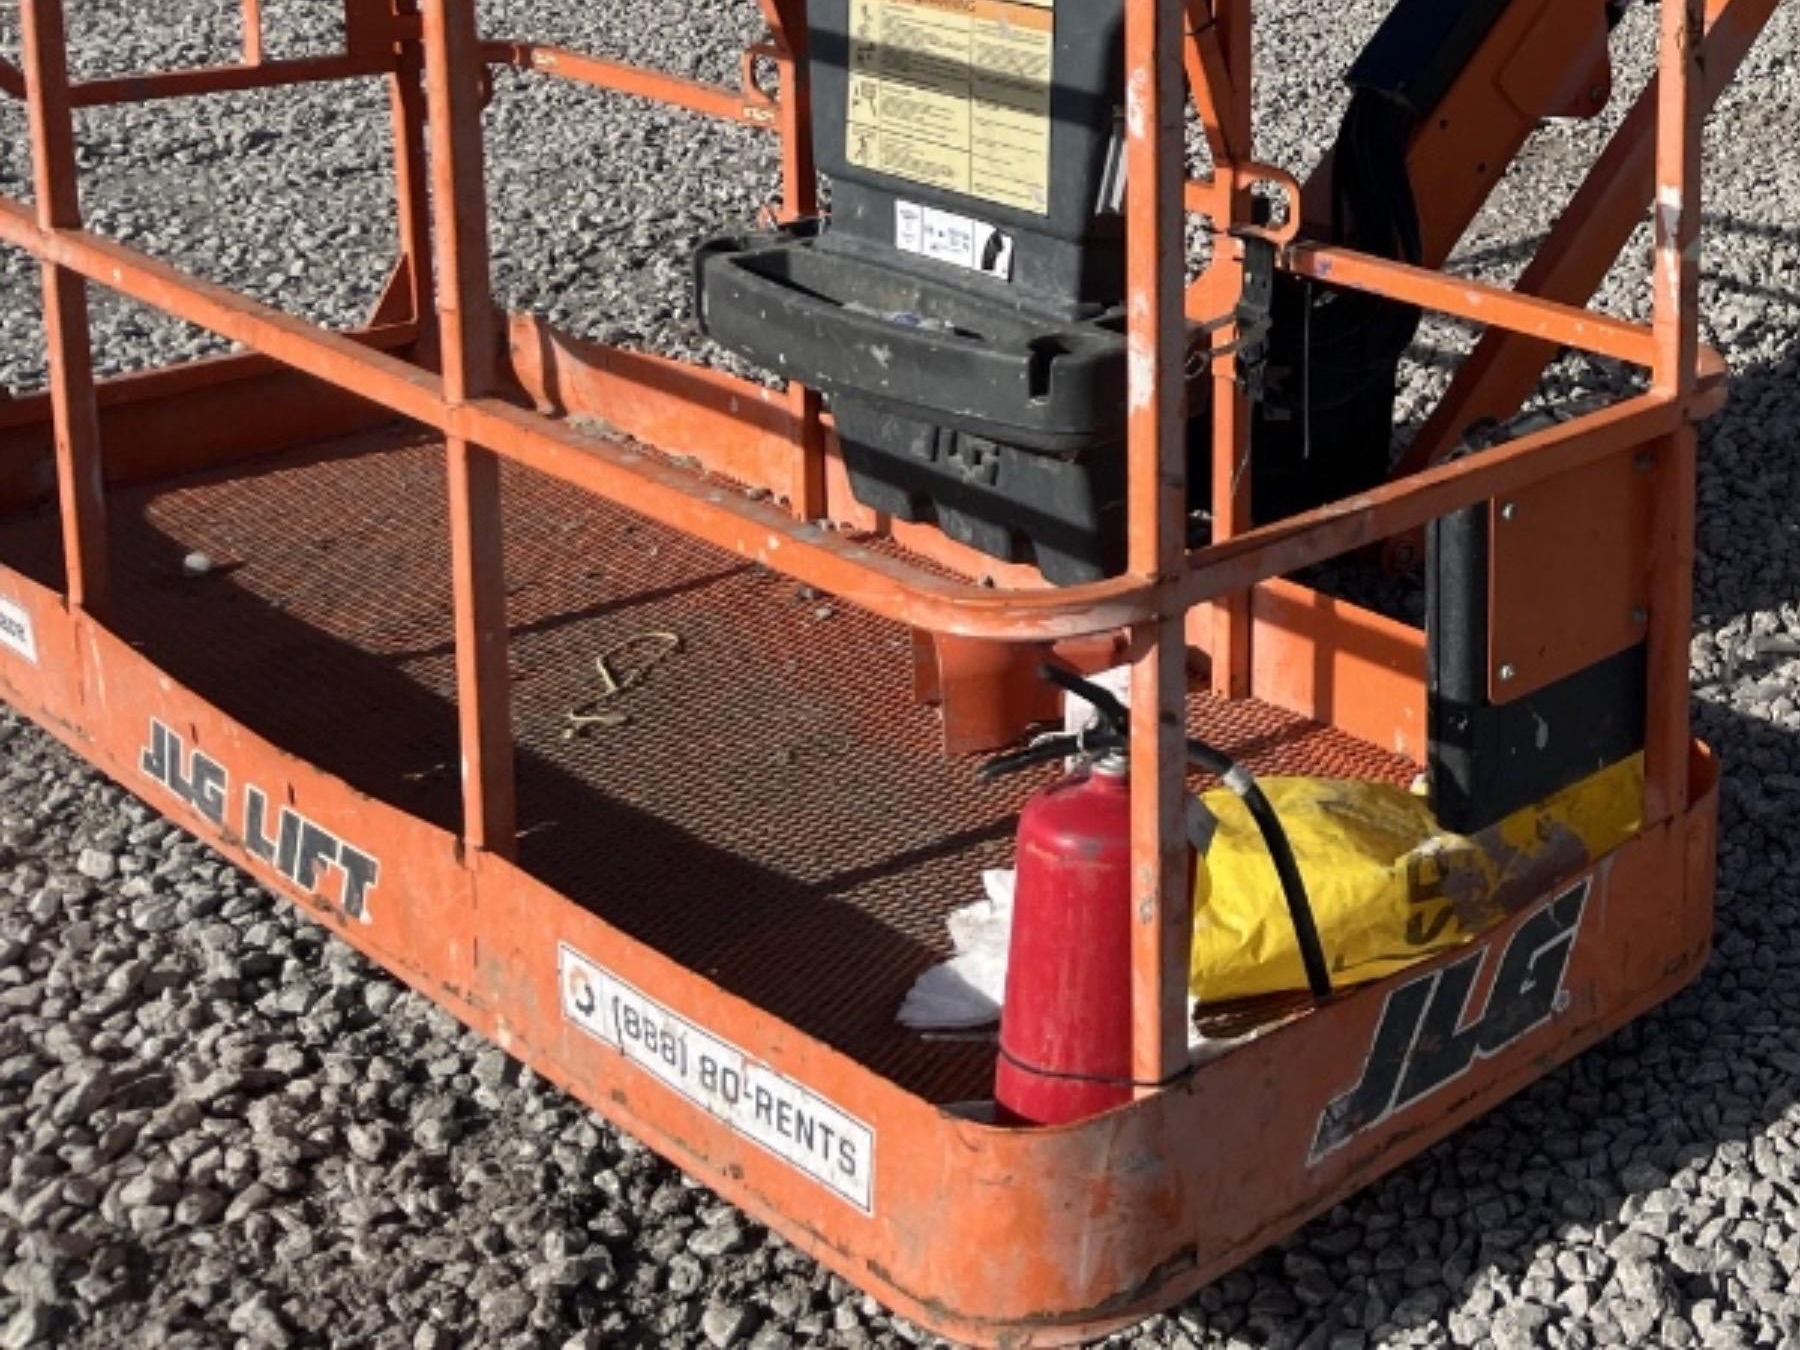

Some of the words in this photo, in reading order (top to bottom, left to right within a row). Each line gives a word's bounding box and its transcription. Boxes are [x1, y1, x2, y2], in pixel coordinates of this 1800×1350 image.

[140, 716, 229, 828] JLG
[244, 782, 382, 922] LIFT
[612, 995, 688, 1078] (888)
[1304, 874, 1593, 1168] JLG
